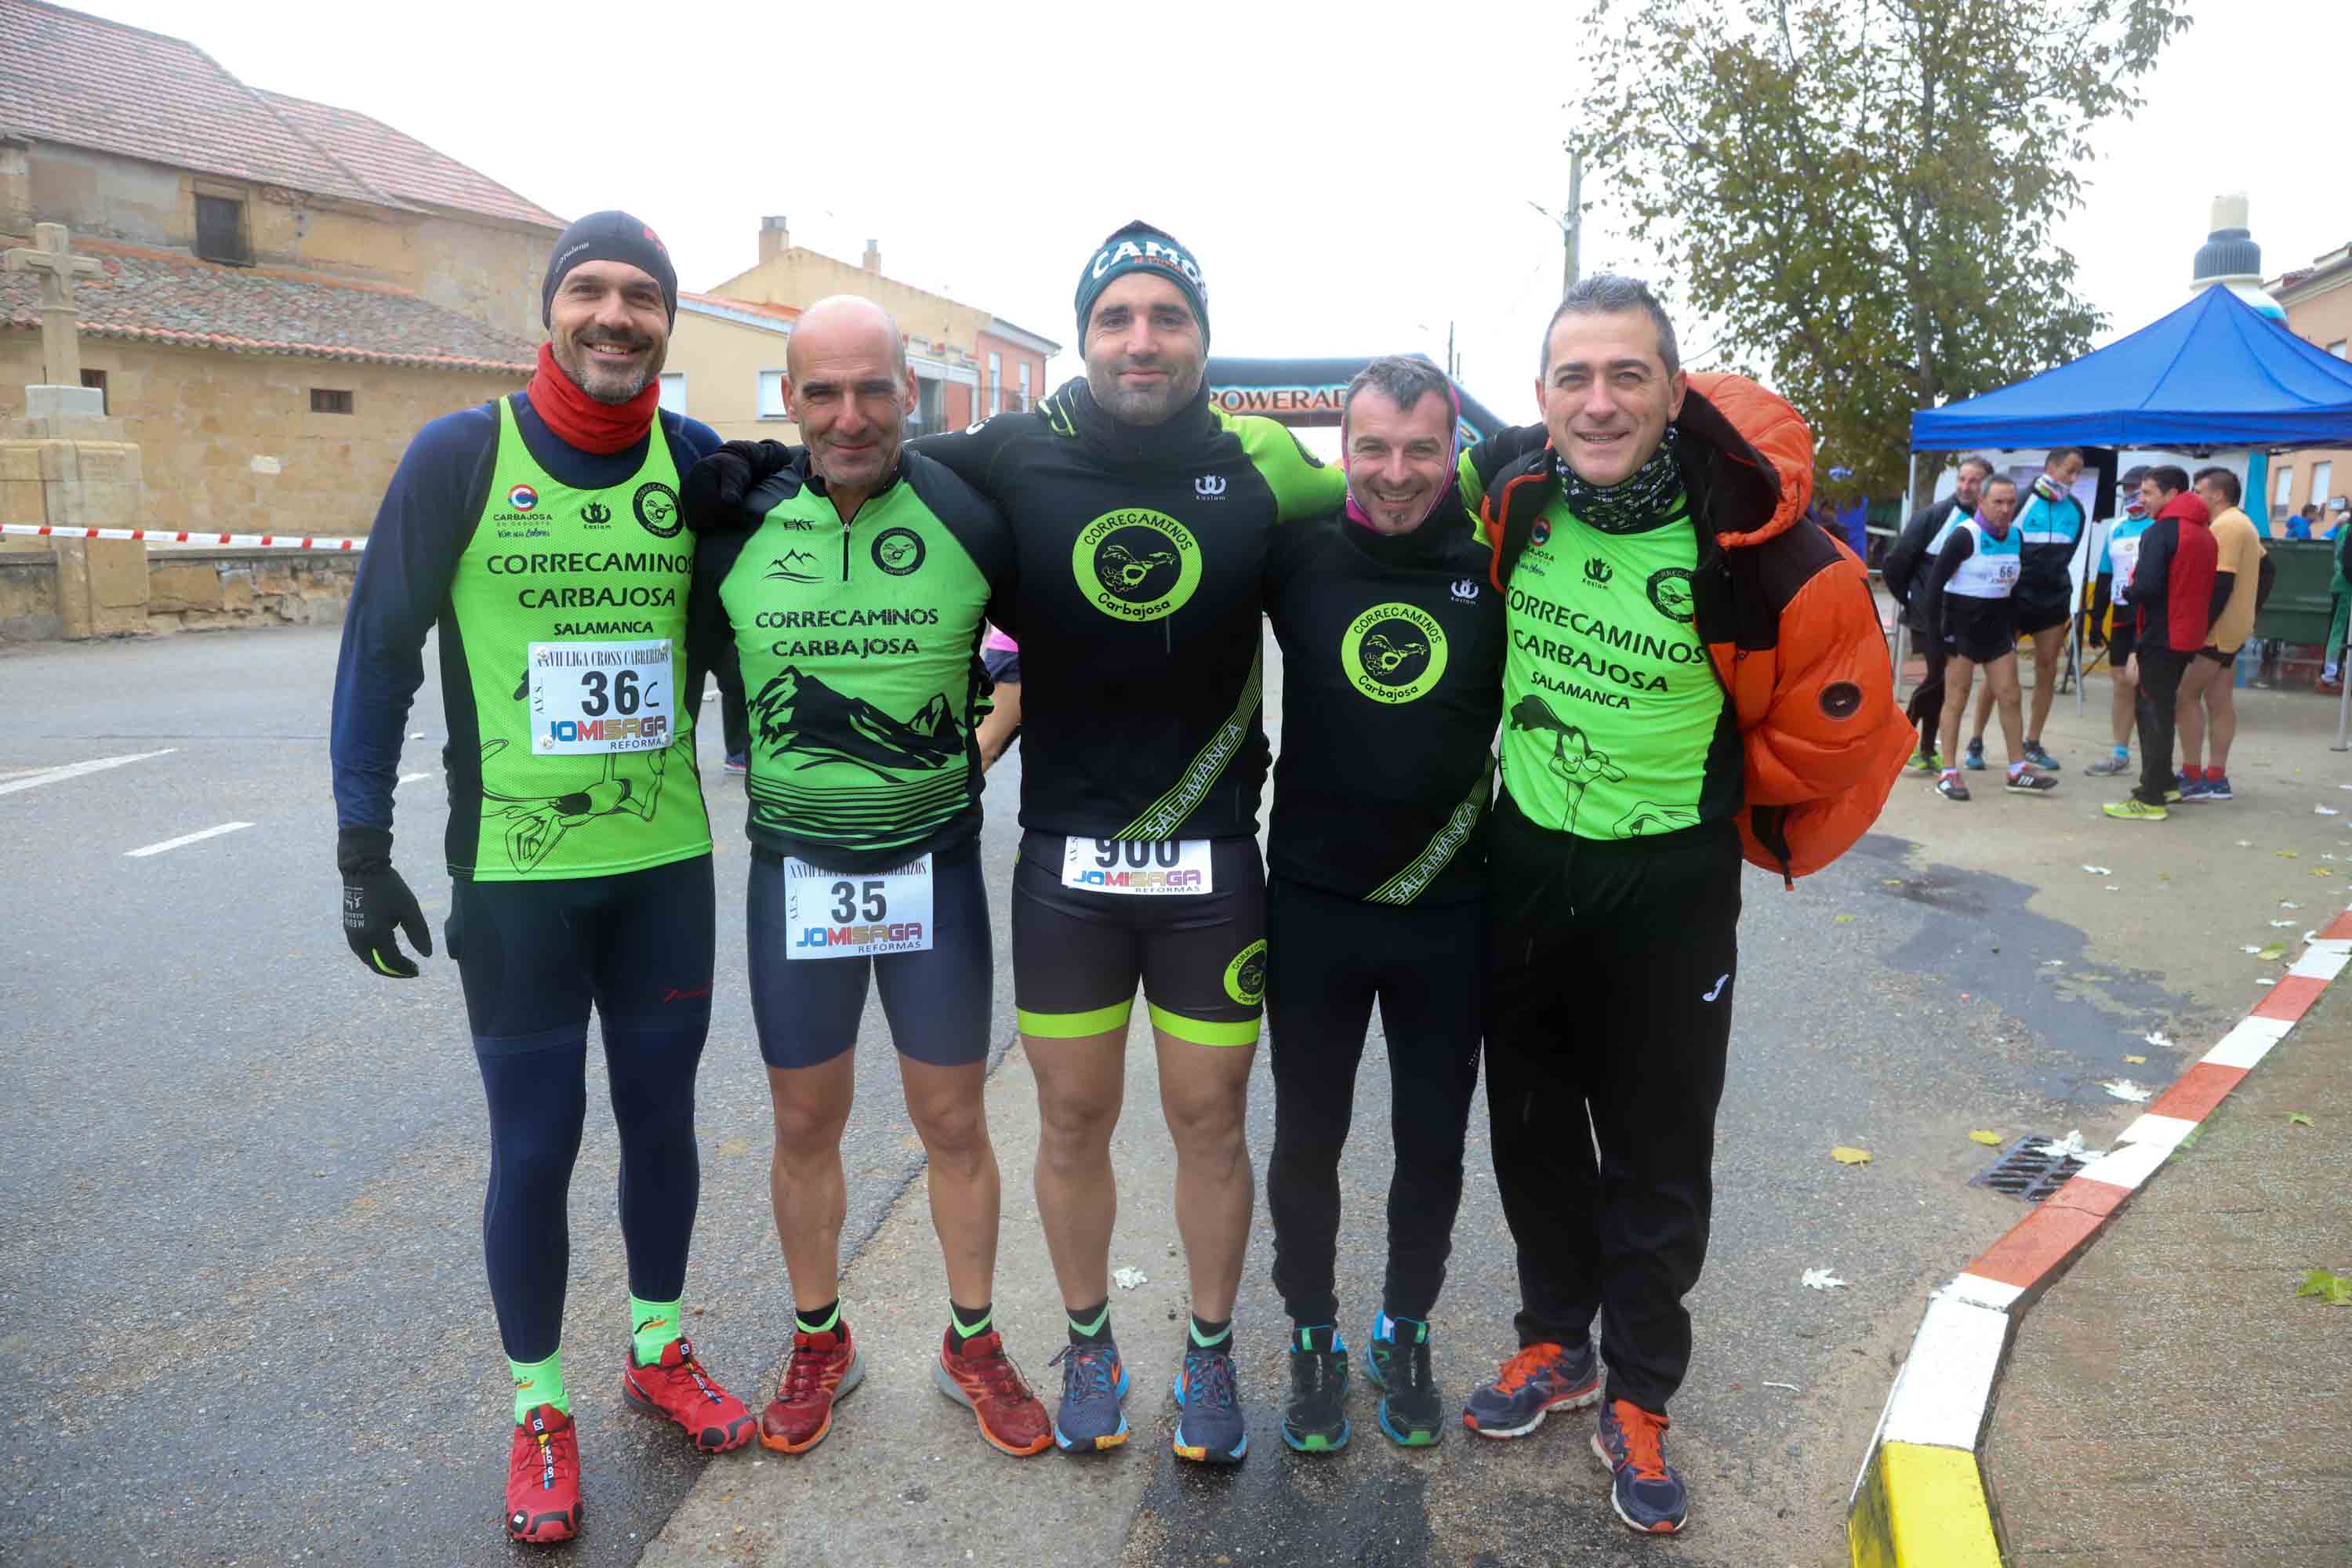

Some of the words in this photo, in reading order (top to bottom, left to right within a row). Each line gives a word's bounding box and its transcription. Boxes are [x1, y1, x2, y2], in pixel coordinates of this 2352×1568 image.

[1084, 512, 1194, 551] CORRECAMINOS
[518, 587, 676, 608] CARBAJOSA
[1098, 591, 1171, 620] Carbajosa
[554, 621, 654, 636] SALAMANCA
[755, 608, 938, 628] CORRECAMINOS
[1354, 607, 1443, 644] CORRECAMINOS
[1506, 585, 1711, 665] CORRECAMINOS
[566, 651, 588, 666] LIGA
[591, 650, 622, 666] CROSS
[771, 638, 920, 659] CARBAJOSA
[1514, 629, 1668, 692] CARBAJOSA
[581, 670, 640, 717] 36
[1359, 675, 1419, 702] Carbajosa
[1531, 671, 1631, 710] SALAMANCA
[610, 738, 666, 750] REFORMA
[1094, 840, 1180, 868] 900
[1073, 869, 1201, 886] JOMISAGA
[831, 880, 887, 924] 35
[797, 922, 923, 947] JOMISAGA
[858, 942, 921, 953] REFORMAS
